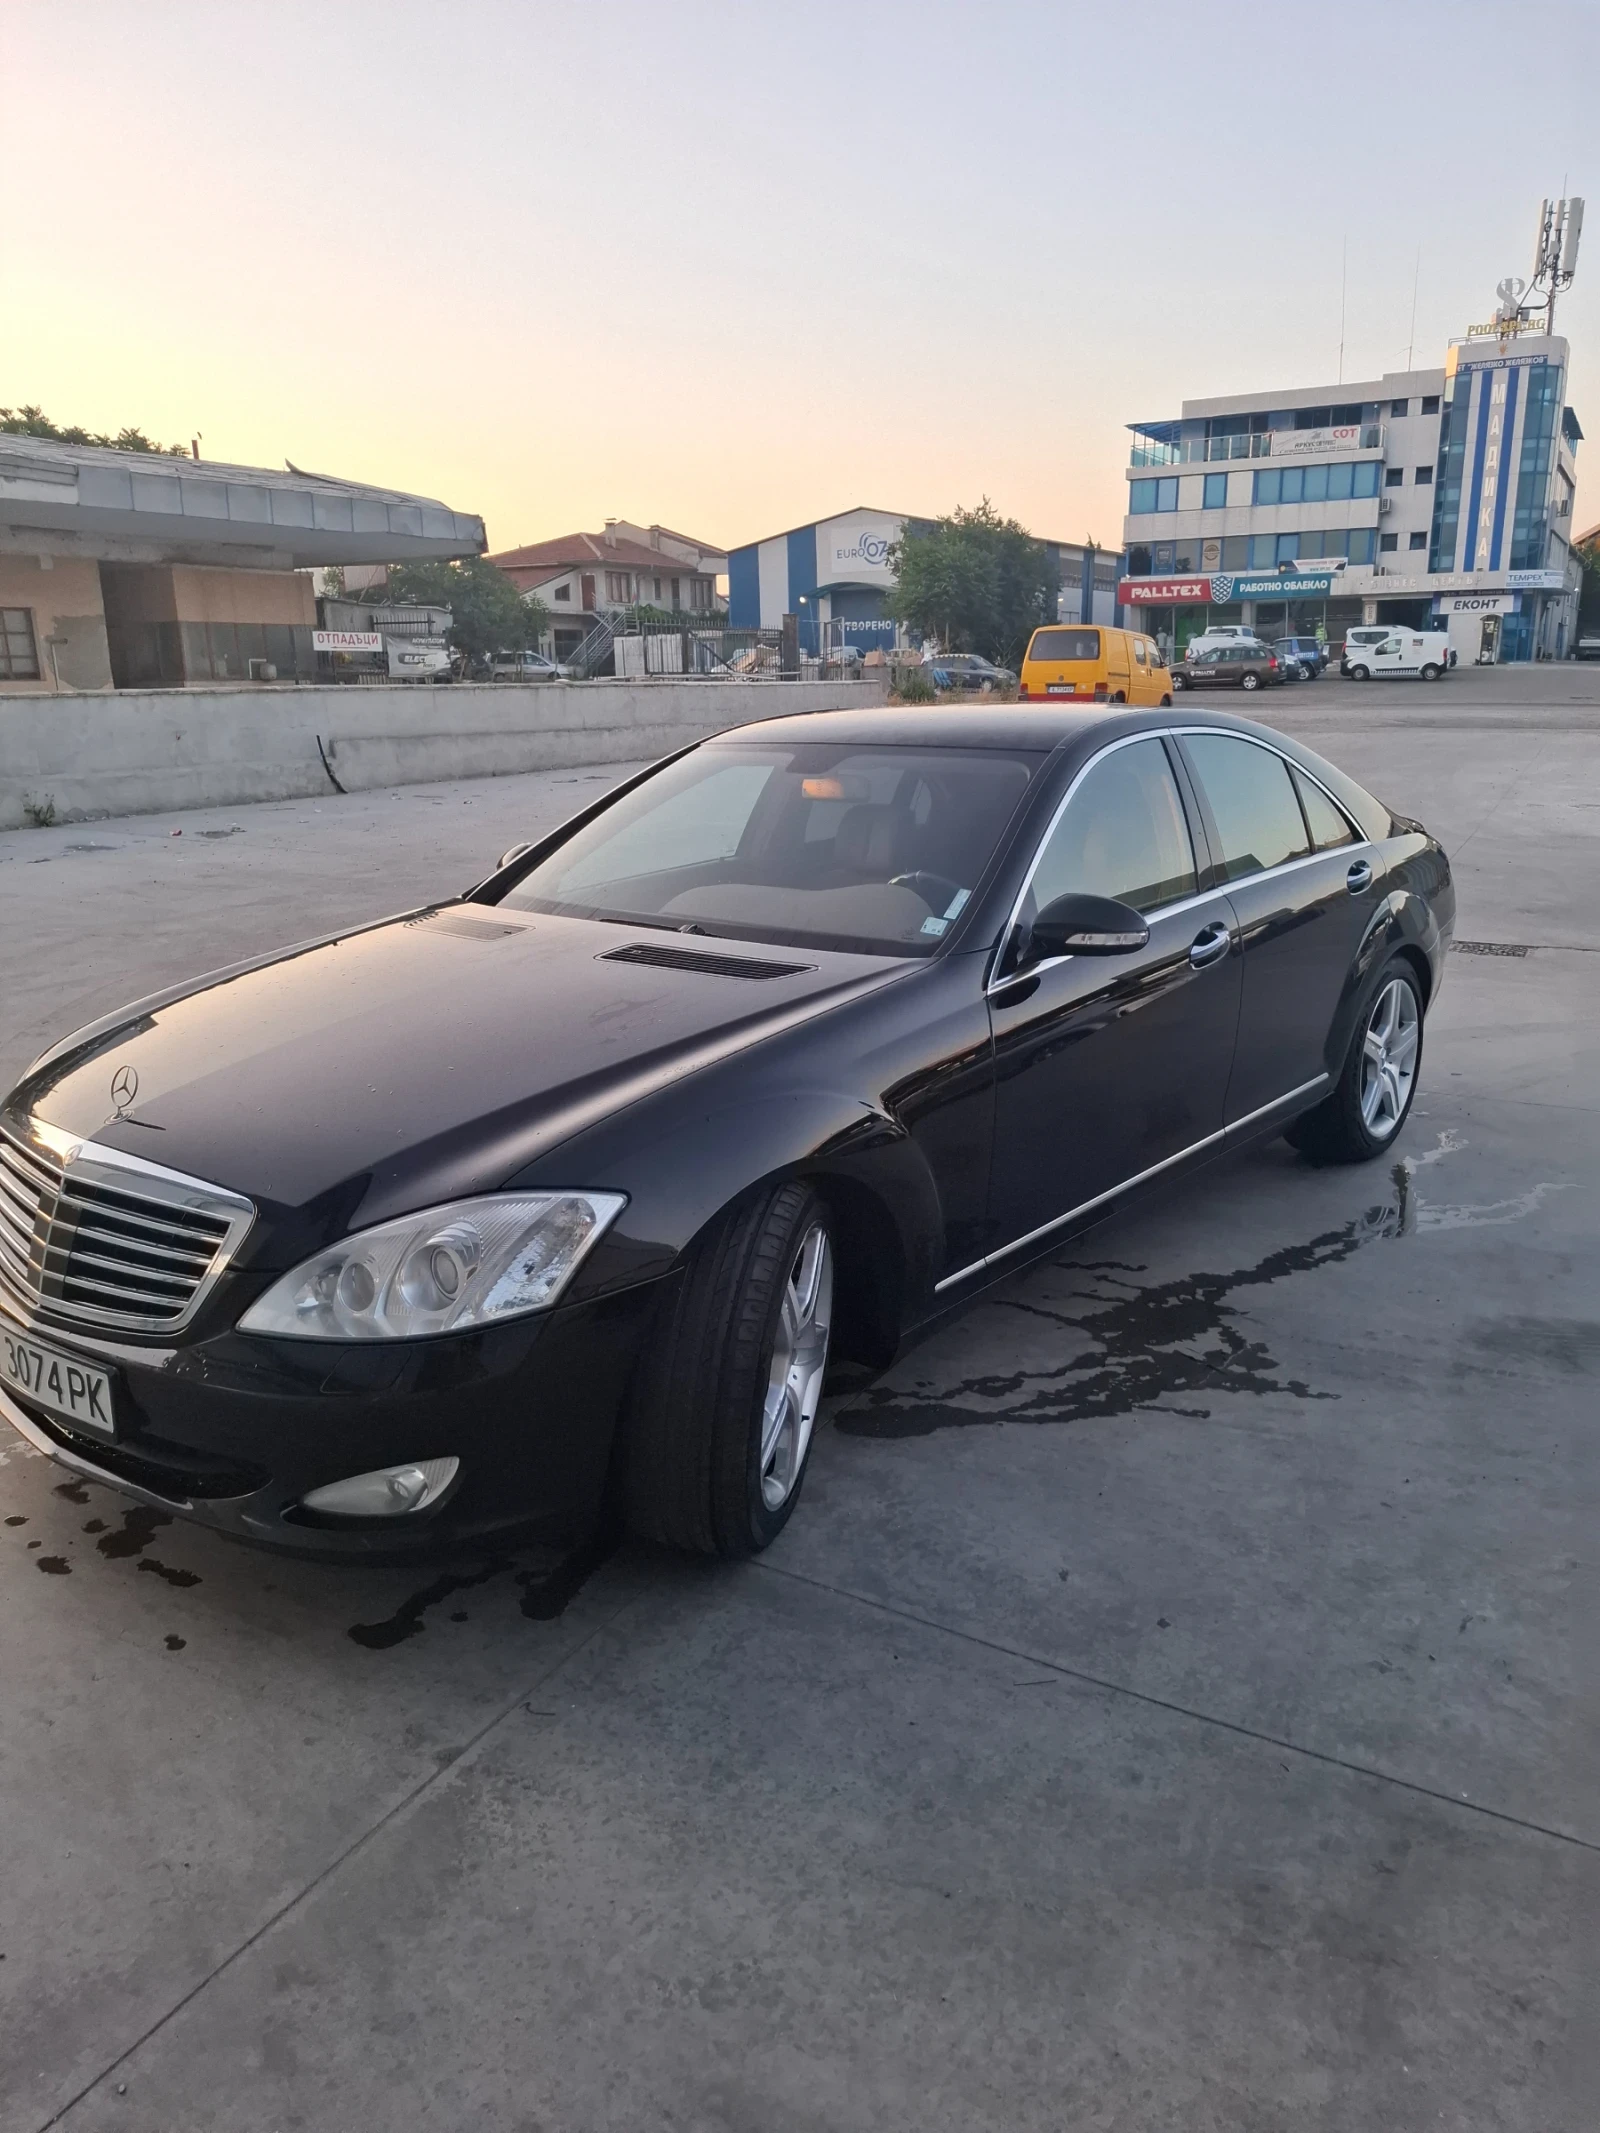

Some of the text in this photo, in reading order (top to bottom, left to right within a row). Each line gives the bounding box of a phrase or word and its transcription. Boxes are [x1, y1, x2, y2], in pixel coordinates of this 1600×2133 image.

[1333, 428, 1357, 439] СОТ
[1478, 383, 1506, 557] МАДИКА
[836, 548, 866, 559] EURO
[1508, 574, 1543, 582] TEMPEX
[1131, 584, 1202, 599] PALLTEX
[1240, 580, 1328, 592] РАБОТНО ОБЛЕКЛО
[1453, 599, 1500, 610] ЕКОНТ
[317, 633, 379, 646] ОТПАДЪЦИ
